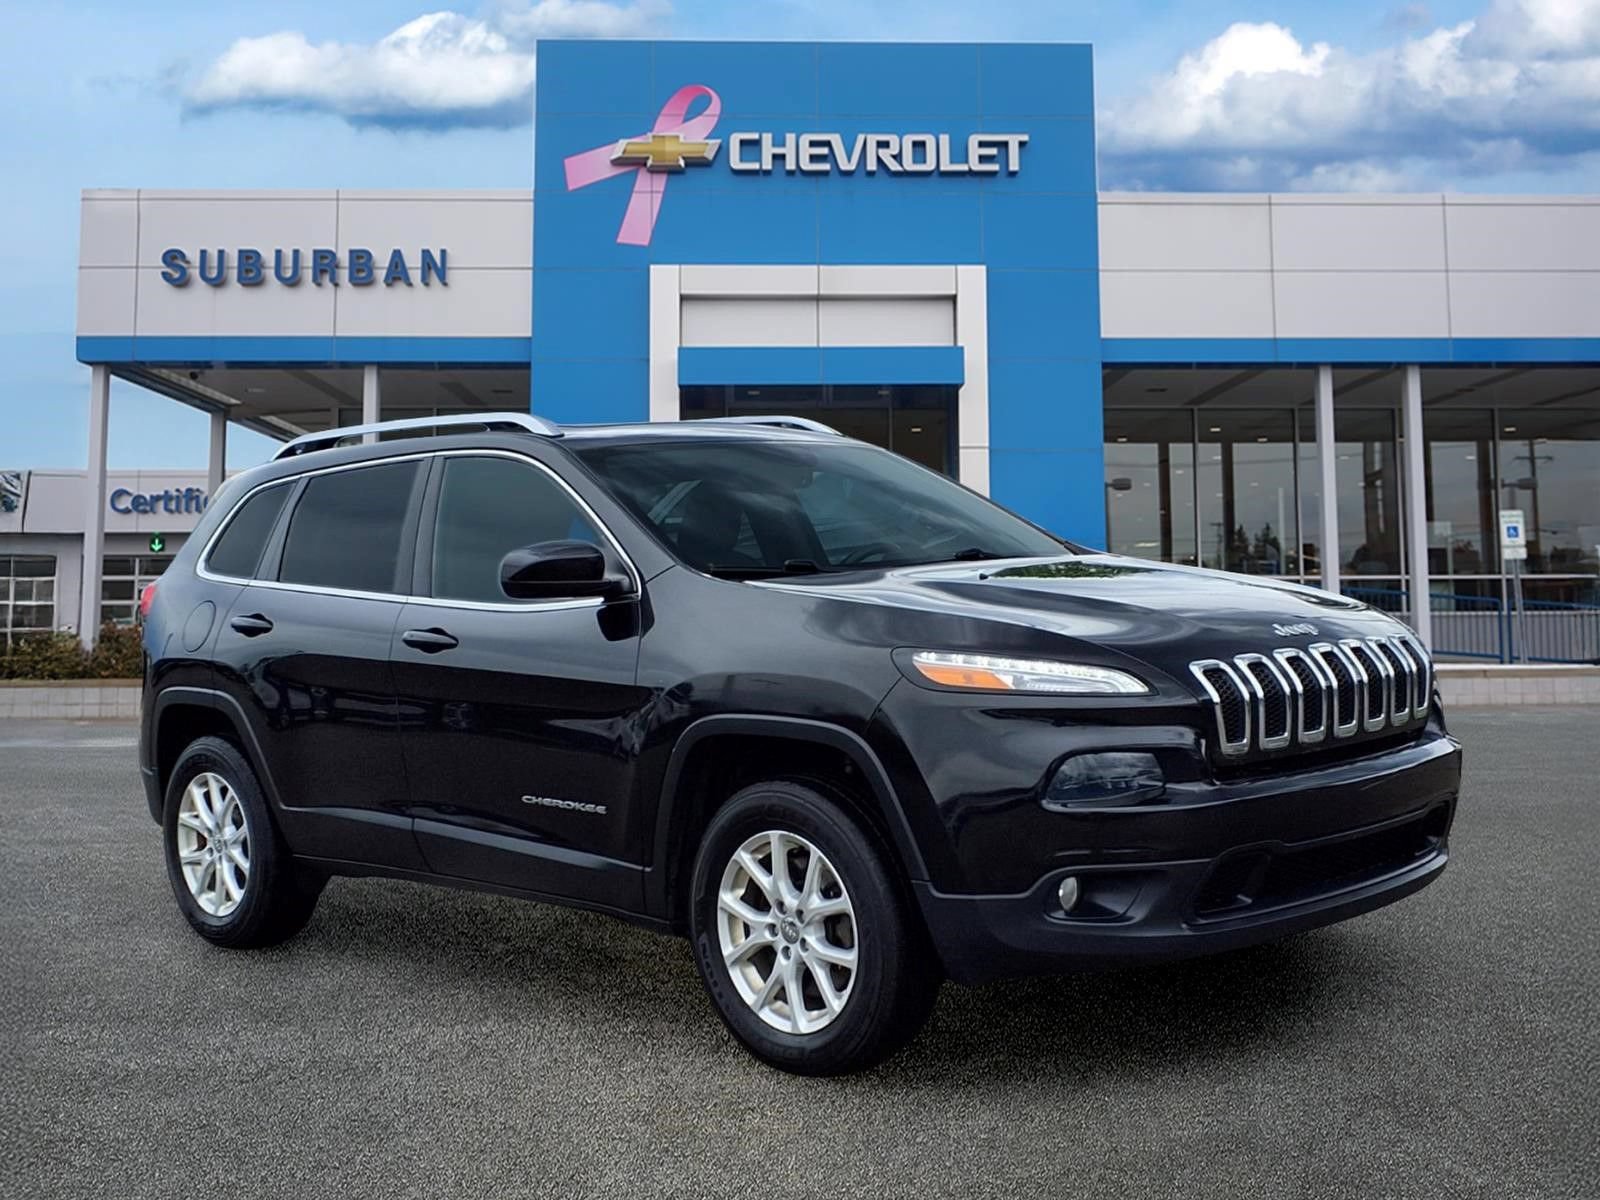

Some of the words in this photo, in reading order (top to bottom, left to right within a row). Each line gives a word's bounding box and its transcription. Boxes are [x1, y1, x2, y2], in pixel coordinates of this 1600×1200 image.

[729, 132, 1029, 173] CHEVROLET
[161, 248, 449, 286] SUBURBAN
[110, 487, 208, 514] Certifi
[1272, 623, 1319, 636] Jeep
[521, 795, 607, 814] CHEROKEE
